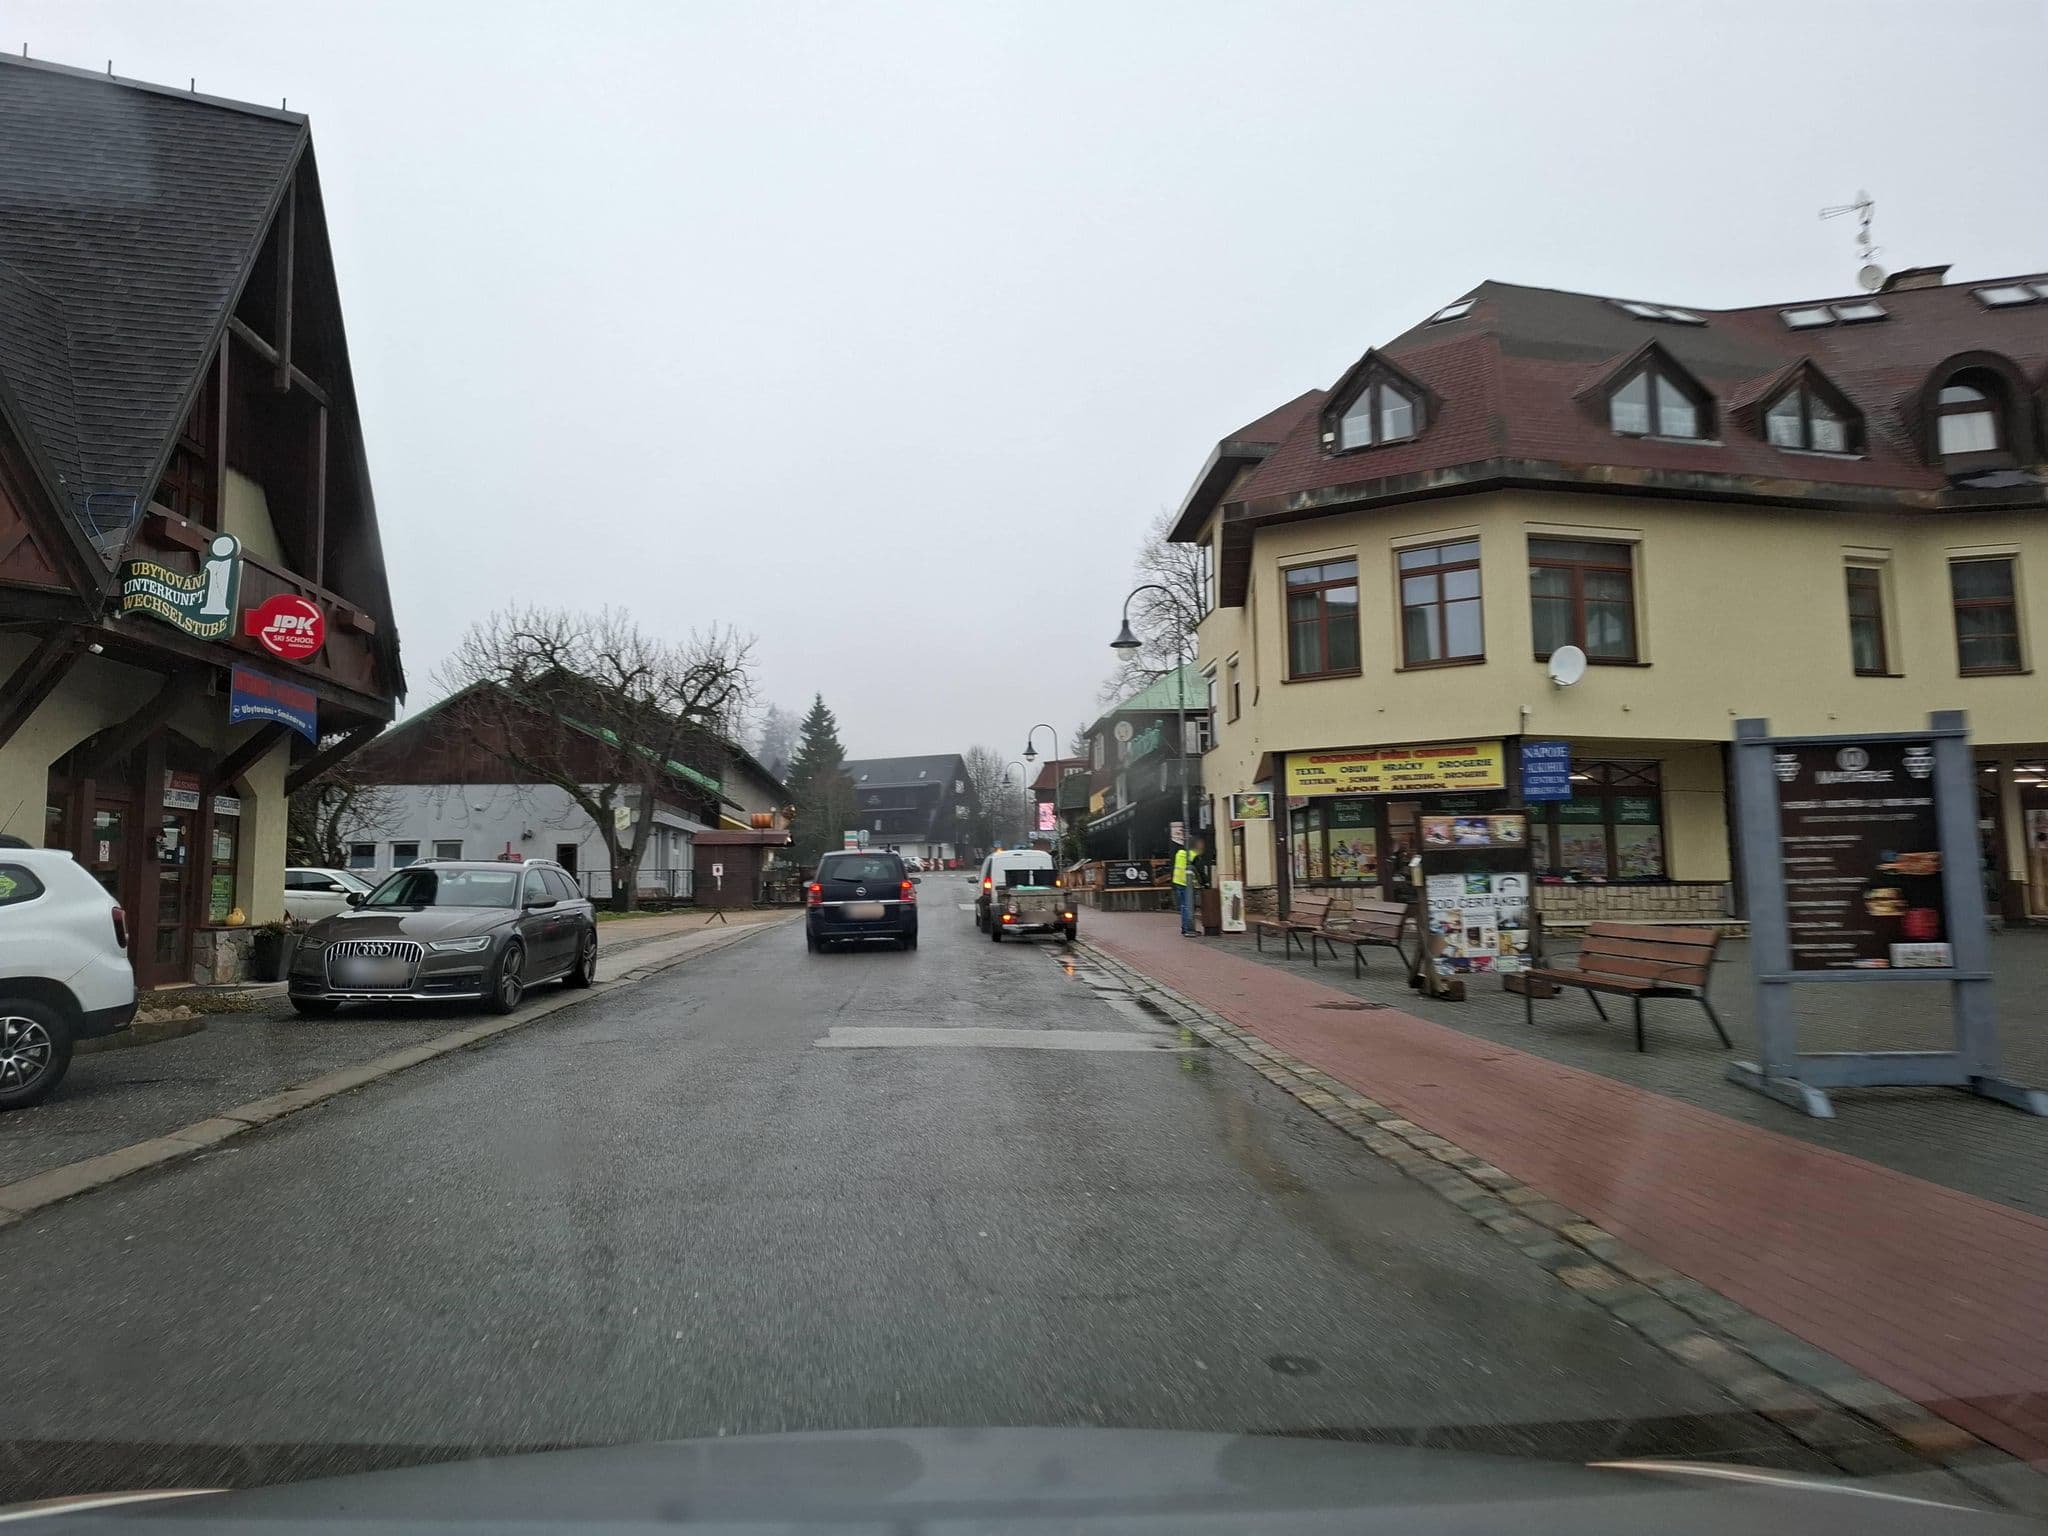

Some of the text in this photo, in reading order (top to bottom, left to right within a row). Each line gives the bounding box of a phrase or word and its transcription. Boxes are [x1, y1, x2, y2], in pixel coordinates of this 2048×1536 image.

[131, 562, 208, 590] UBYTOVÁNÍ
[124, 578, 206, 606] UNTERKUNFT
[123, 593, 228, 637] WECHSELSTUBE
[263, 614, 317, 636] JPK
[272, 634, 315, 645] SKI SCHOOL
[1522, 745, 1568, 758] NÁPOJE
[1295, 758, 1493, 776] TEXTIL OBUV HRAČKY DROGERIE
[1443, 771, 1489, 779] DROGERIE
[1335, 784, 1380, 793] NÁPOJE
[1391, 783, 1448, 791] ALKOHOL
